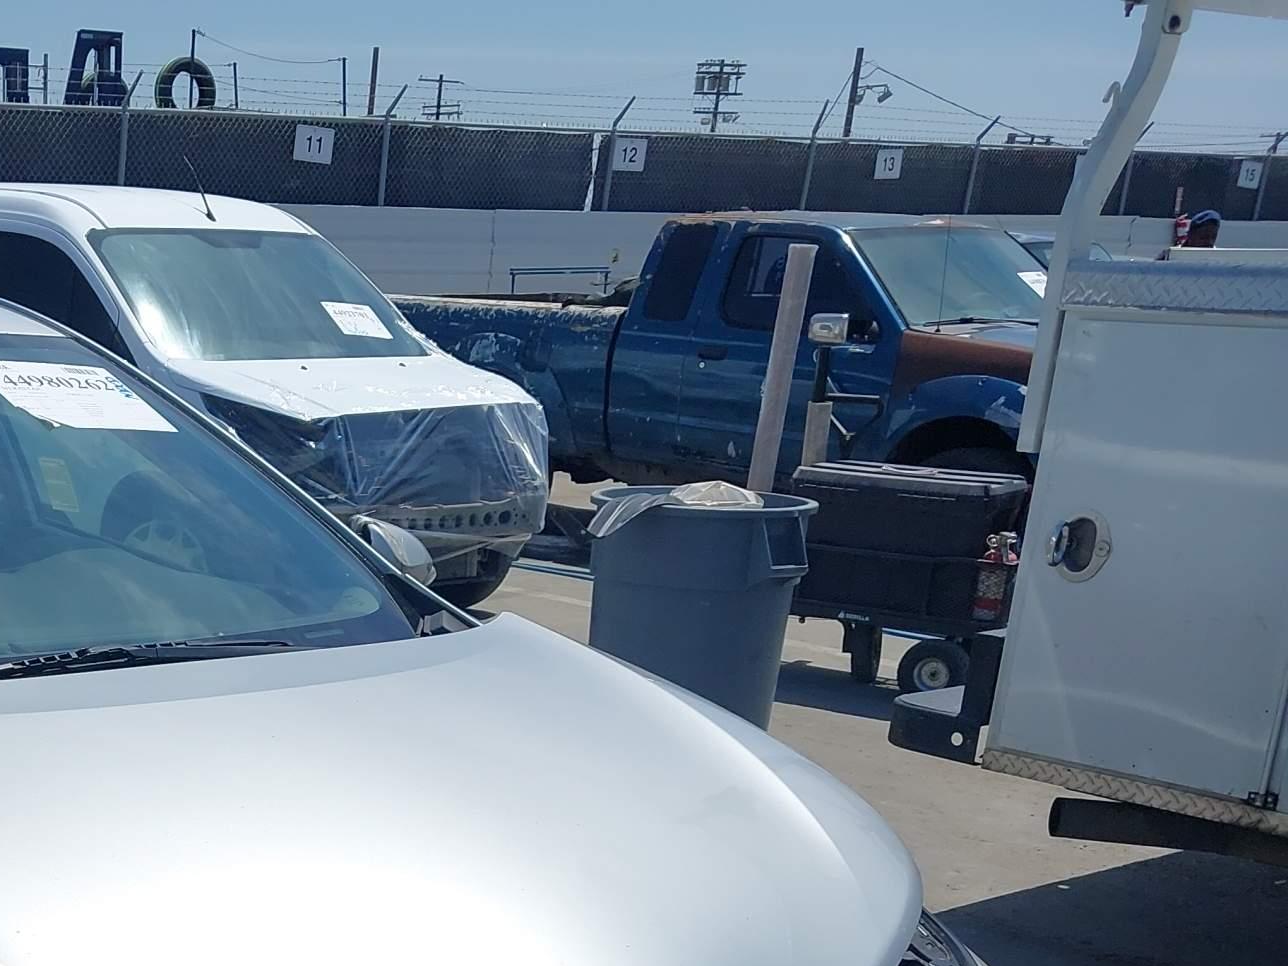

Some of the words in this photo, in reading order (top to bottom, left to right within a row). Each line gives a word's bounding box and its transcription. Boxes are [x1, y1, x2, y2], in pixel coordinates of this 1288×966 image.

[306, 135, 323, 154] 11
[621, 146, 638, 163] 12
[883, 156, 895, 172] 13
[1245, 168, 1256, 182] 15
[3, 374, 115, 391] 44980262
